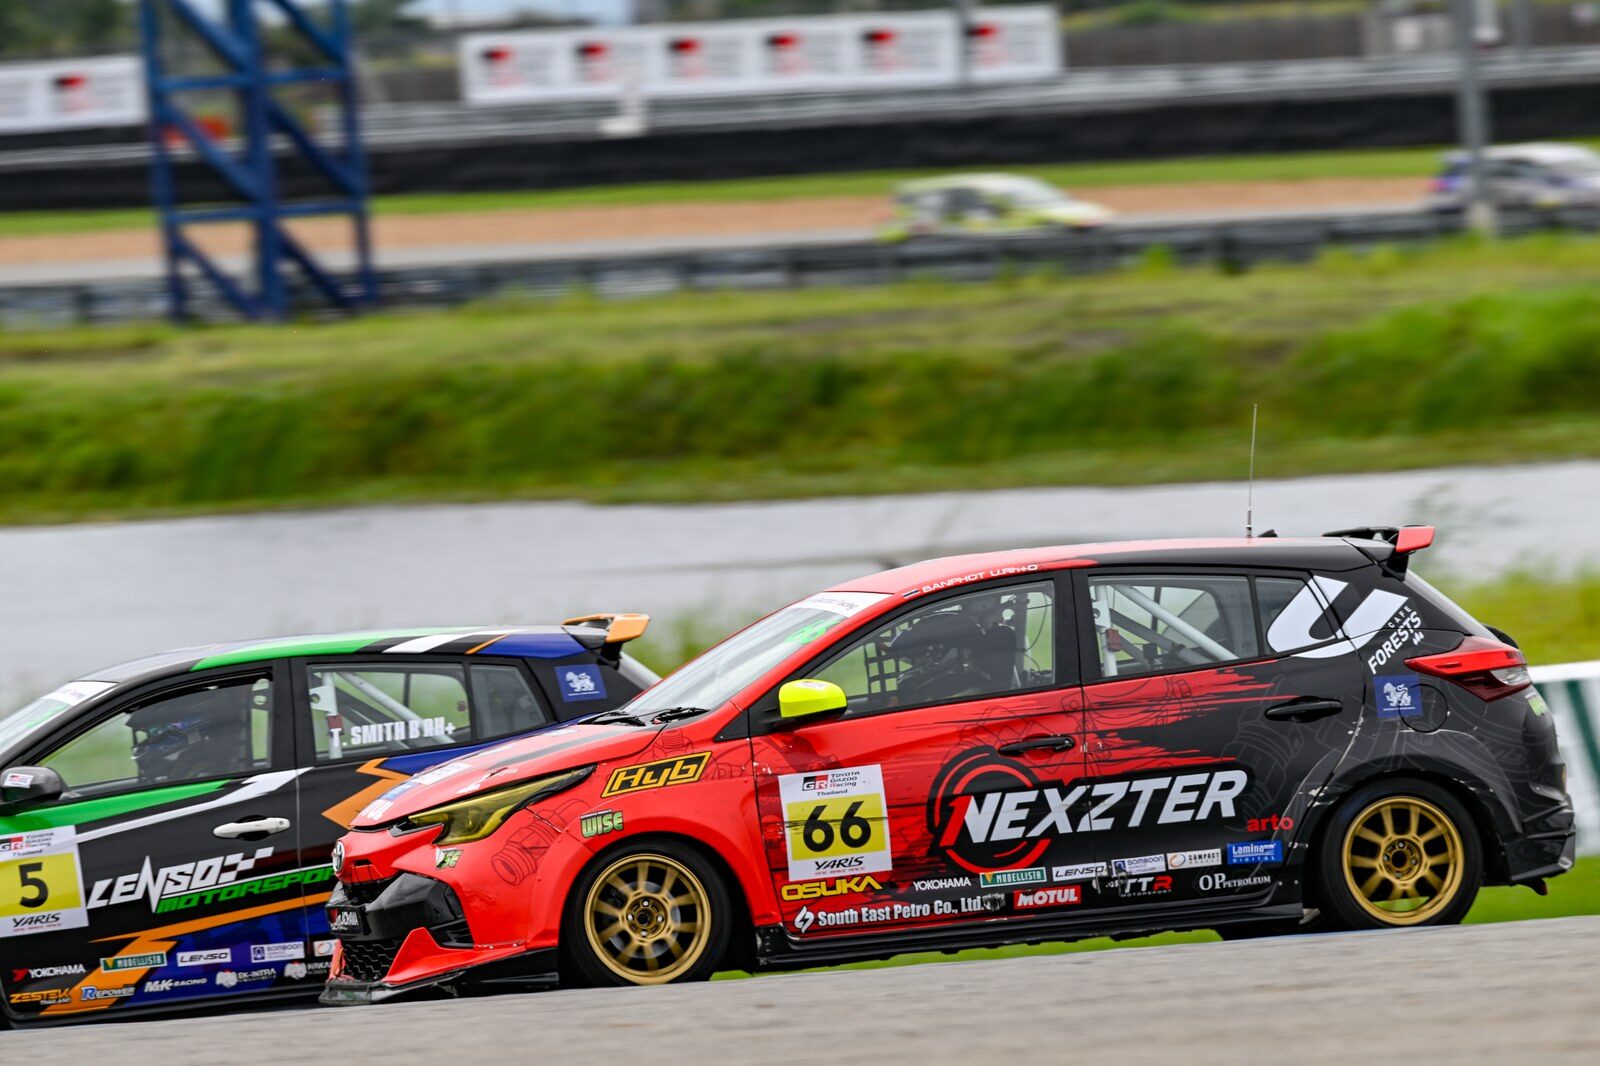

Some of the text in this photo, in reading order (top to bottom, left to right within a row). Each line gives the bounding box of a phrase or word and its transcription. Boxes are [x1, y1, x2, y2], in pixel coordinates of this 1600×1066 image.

[922, 572, 985, 593] BANPHOT
[1387, 605, 1412, 629] CAFE
[1367, 610, 1422, 675] FORESTS
[351, 720, 406, 746] SMITH
[408, 719, 420, 739] B
[610, 759, 698, 791] Hyb
[829, 780, 857, 788] Racing
[817, 788, 848, 796] Thailand
[939, 769, 1248, 847] NEXZTER
[581, 810, 624, 839] WISE
[803, 800, 872, 853] 66
[1246, 815, 1294, 832] arto
[814, 855, 865, 871] YARIS
[1188, 852, 1220, 861] COMPACT
[1232, 855, 1275, 863] DIGITAL
[996, 870, 1042, 884] MODELLISTA
[1055, 865, 1105, 879] LENSO
[18, 862, 49, 908] 5
[86, 855, 224, 914] LENSO
[781, 874, 883, 901] OSUKA
[913, 876, 972, 891] YOKOHAMA
[1017, 888, 1078, 907] MOTUL
[817, 894, 985, 927] South East Petro Co., Ltd.
[12, 913, 61, 928] YARIS
[180, 952, 229, 963] LENSO
[28, 964, 86, 979] YOKOHAMA
[10, 988, 71, 1004] ZESTEK
